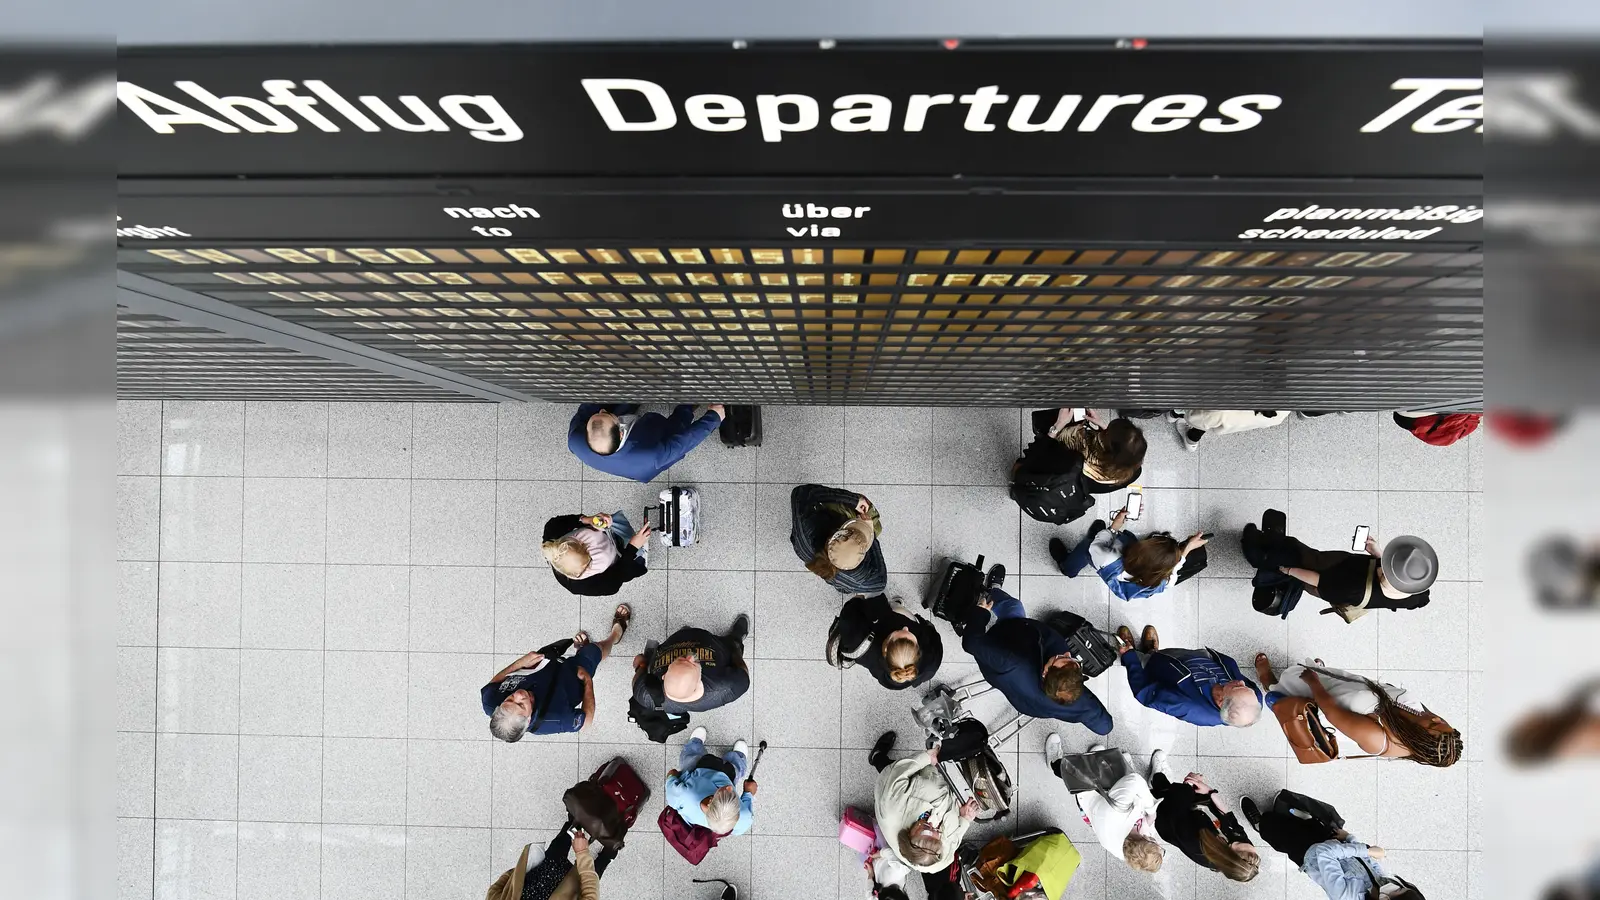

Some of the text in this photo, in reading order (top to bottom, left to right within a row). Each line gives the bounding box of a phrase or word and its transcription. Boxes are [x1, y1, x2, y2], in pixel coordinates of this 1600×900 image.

[117, 77, 1483, 142] Abflug Departures Te
[443, 204, 540, 220] nach
[781, 203, 871, 219] über
[1264, 204, 1483, 224] planmäßig
[471, 225, 512, 238] to
[786, 225, 841, 239] via
[1238, 226, 1441, 240] scheduled
[505, 248, 817, 263] Brindisi
[1194, 251, 1414, 267] 11:00
[215, 272, 300, 284] LH
[363, 272, 473, 284] 103
[537, 272, 857, 285] Frankfurt
[1158, 274, 1356, 288] 11:00
